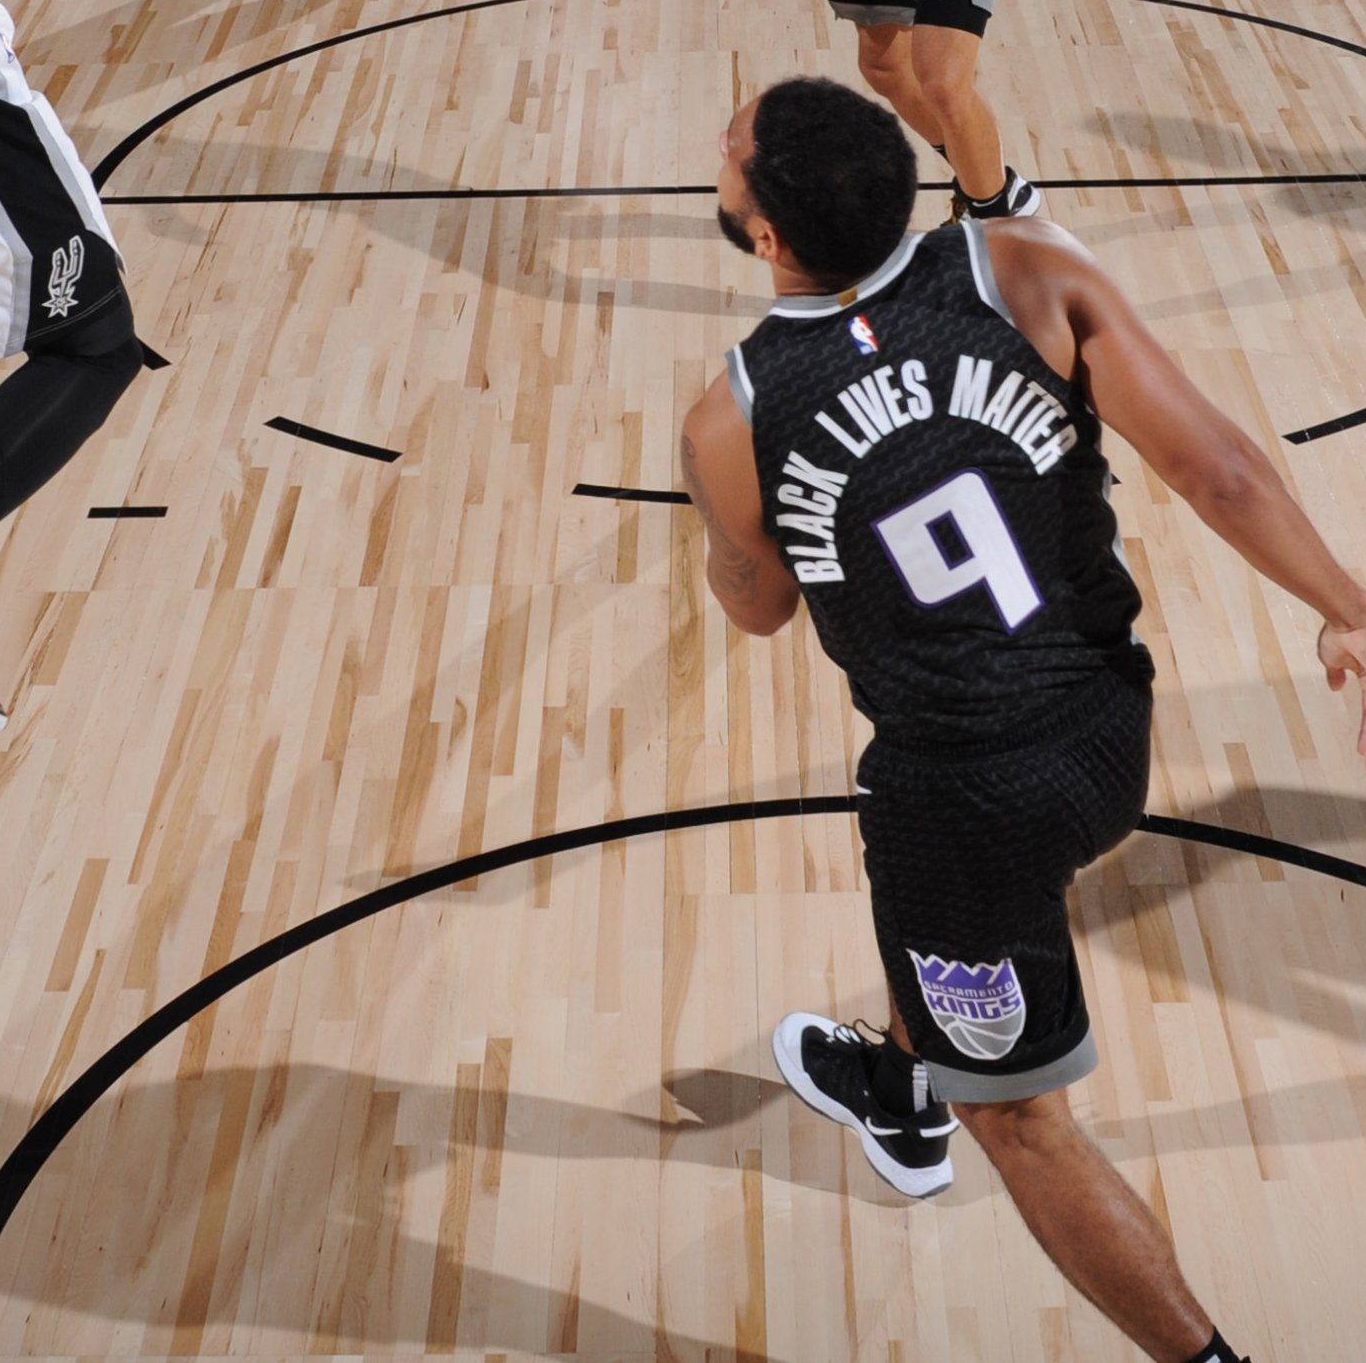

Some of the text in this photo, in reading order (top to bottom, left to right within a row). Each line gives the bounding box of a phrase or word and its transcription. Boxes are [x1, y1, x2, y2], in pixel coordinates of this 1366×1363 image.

[777, 451, 849, 584] BLACK
[814, 359, 934, 459] LIVES
[870, 466, 1046, 636] 9
[924, 981, 1015, 999] SACRAMENTO
[926, 990, 1022, 1020] KINGS
